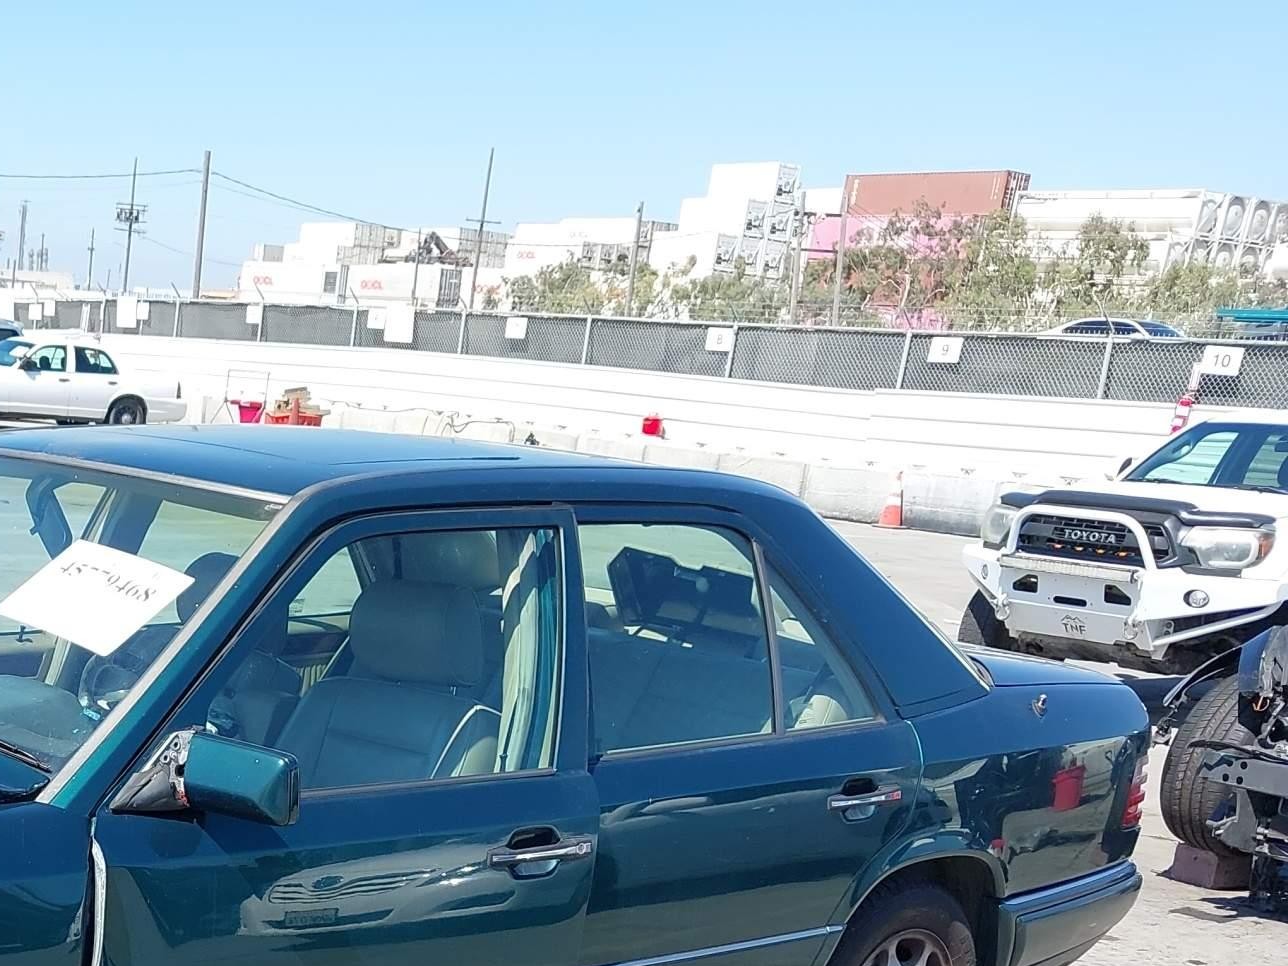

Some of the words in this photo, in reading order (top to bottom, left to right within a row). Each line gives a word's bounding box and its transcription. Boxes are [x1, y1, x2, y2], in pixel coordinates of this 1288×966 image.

[941, 344, 950, 356] 9
[1213, 354, 1231, 368] 10
[1064, 529, 1117, 544] TOYOTA
